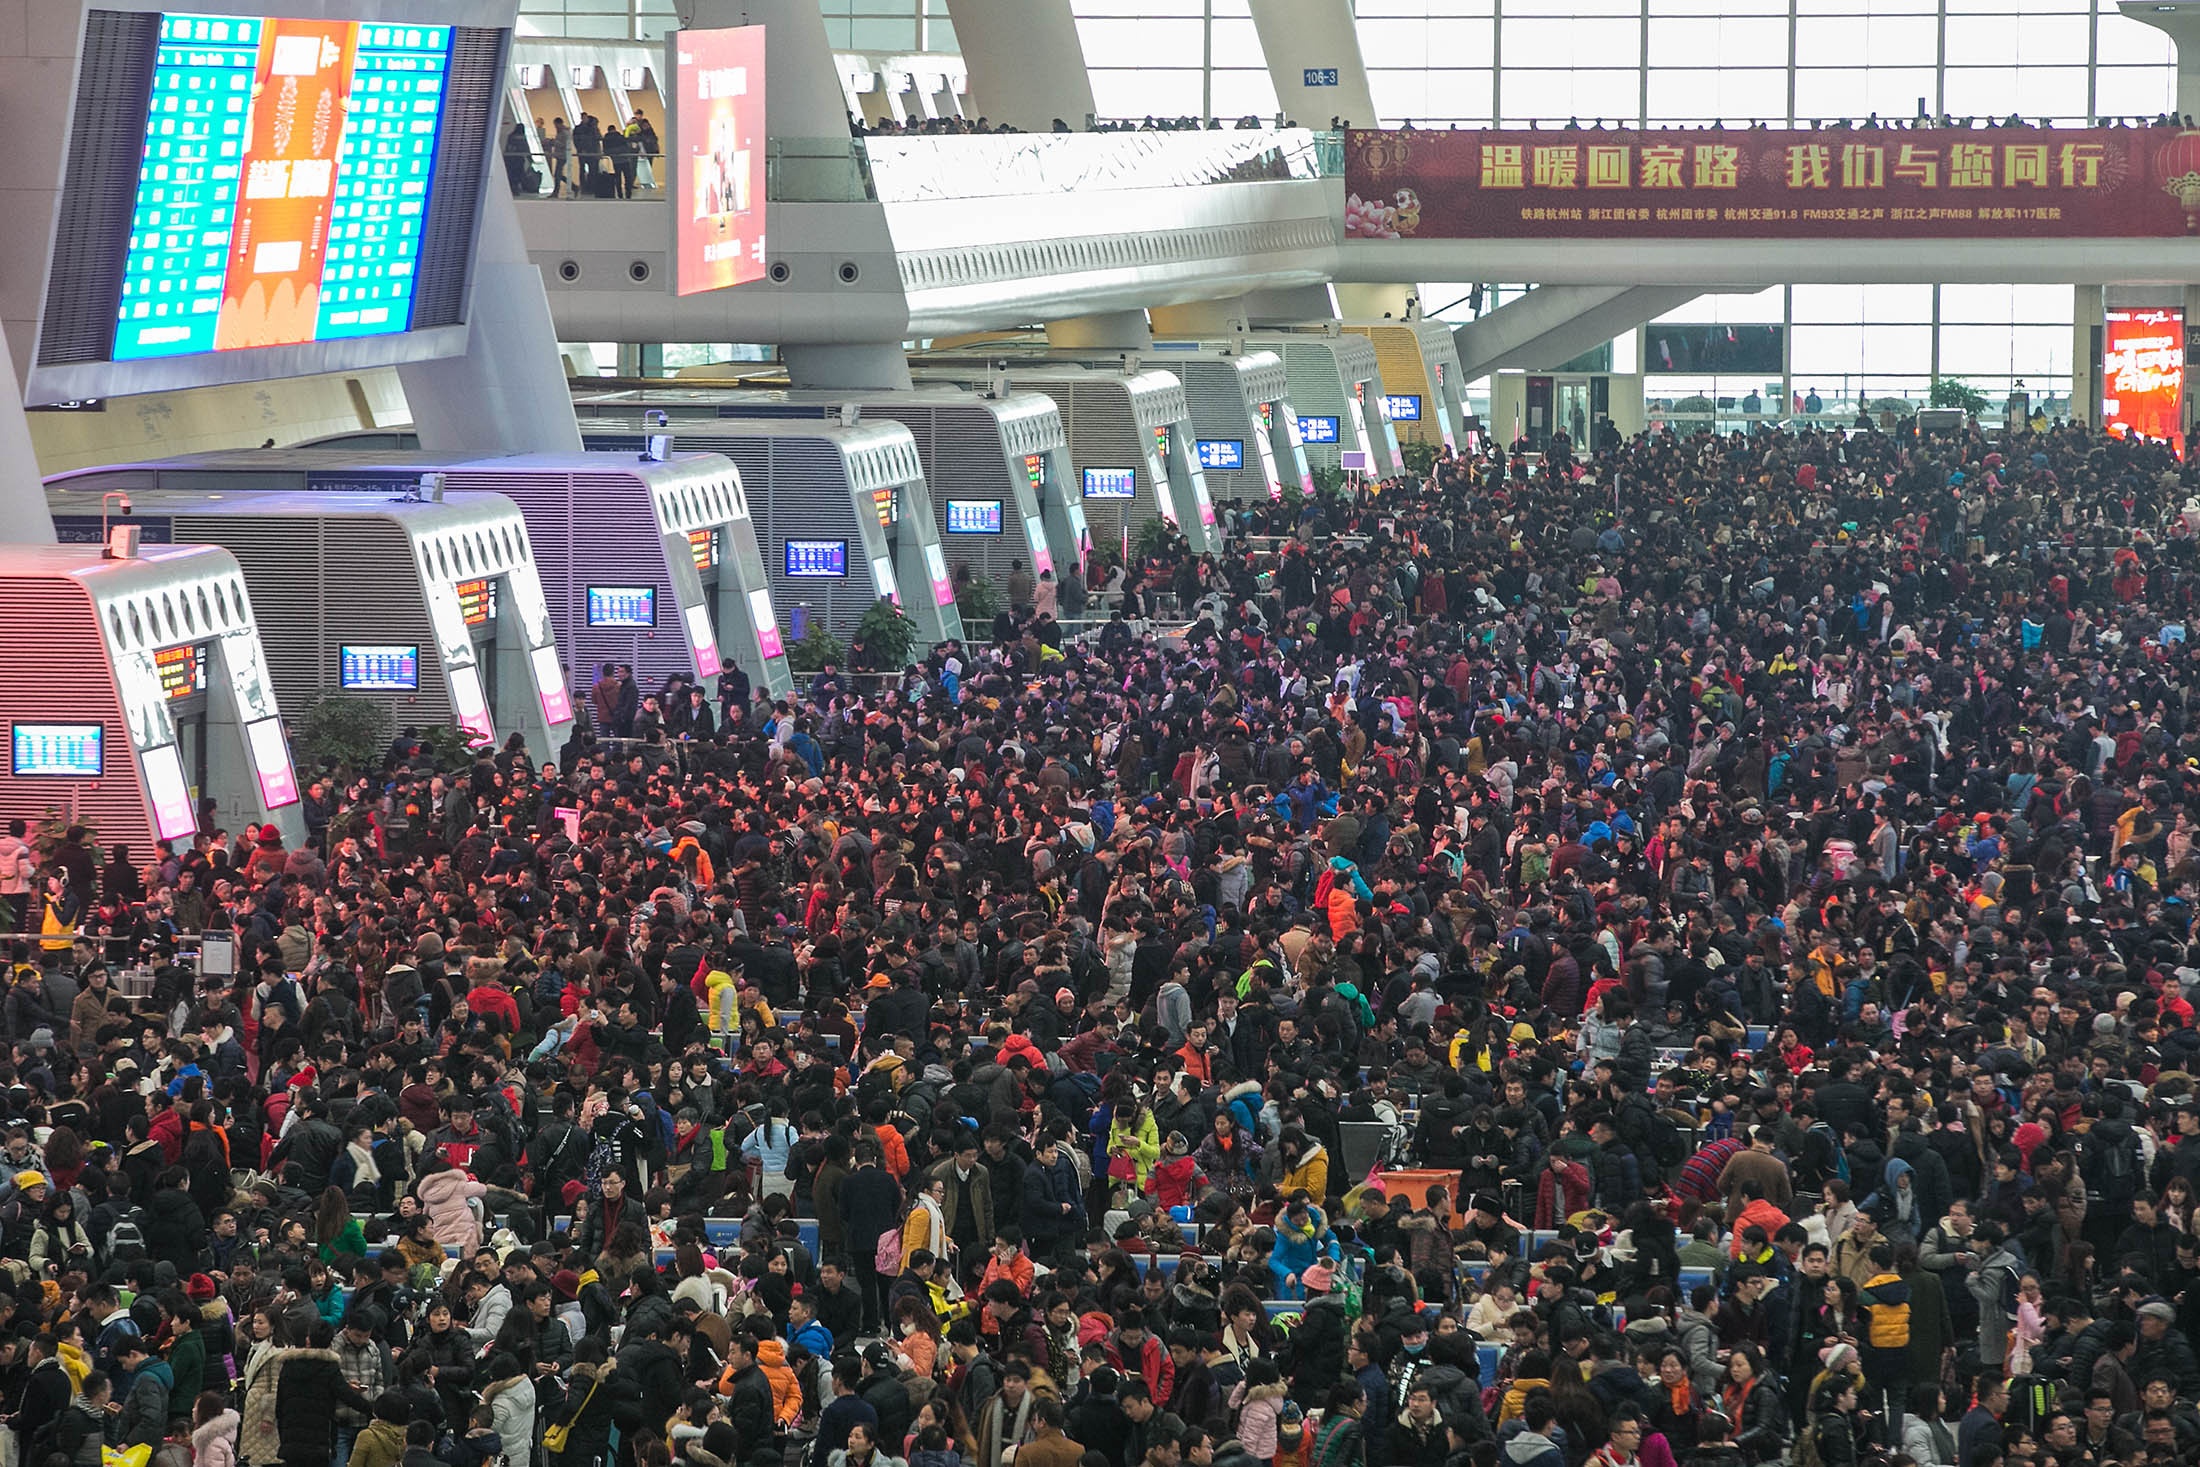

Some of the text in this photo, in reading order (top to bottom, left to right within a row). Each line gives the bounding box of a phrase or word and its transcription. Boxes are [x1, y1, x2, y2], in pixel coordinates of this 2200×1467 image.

[1305, 71, 1336, 84] 106-3
[1480, 143, 2105, 188] 温暖回家路 我们与您同行
[1521, 207, 2062, 220] 铁路杭州站 浙江团省委 杭州团市委 杭州交通91.8 FM93交通之声 浙江之声FM88 解放军117医院
